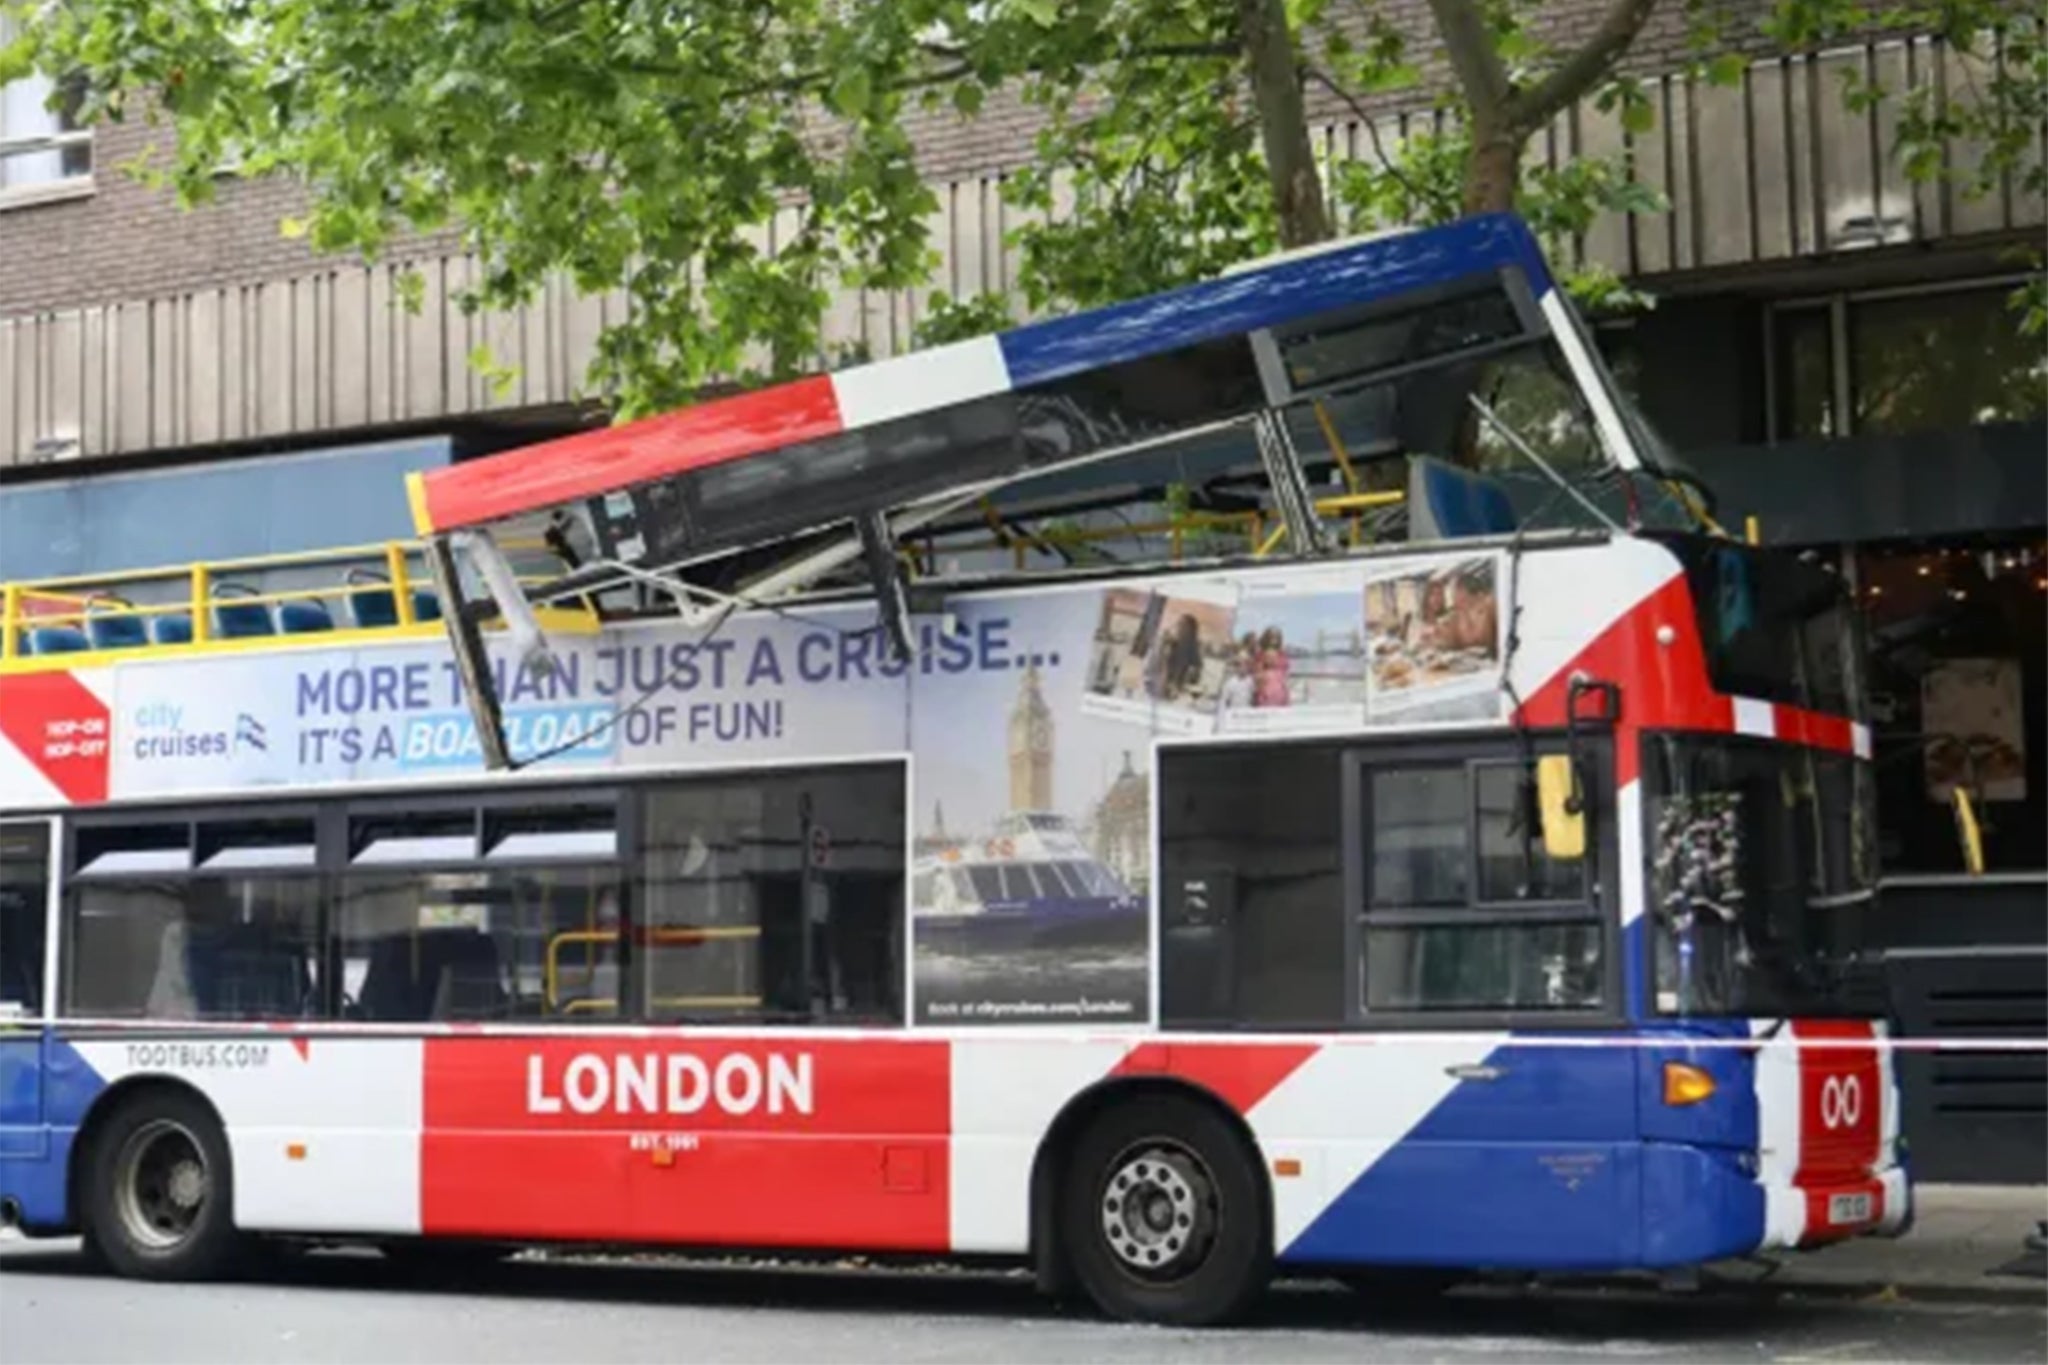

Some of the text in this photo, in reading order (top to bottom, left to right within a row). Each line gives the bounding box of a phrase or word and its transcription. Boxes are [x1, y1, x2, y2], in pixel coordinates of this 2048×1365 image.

[297, 662, 431, 718] MORE
[594, 640, 736, 696] JUST
[746, 638, 783, 685] A
[135, 703, 184, 730] city
[298, 700, 784, 765] IT'S A BOALOAD OF FUN!
[134, 730, 227, 760] cruises
[126, 1044, 270, 1068] TOOTBUS.COM
[526, 1053, 815, 1116] LONDON
